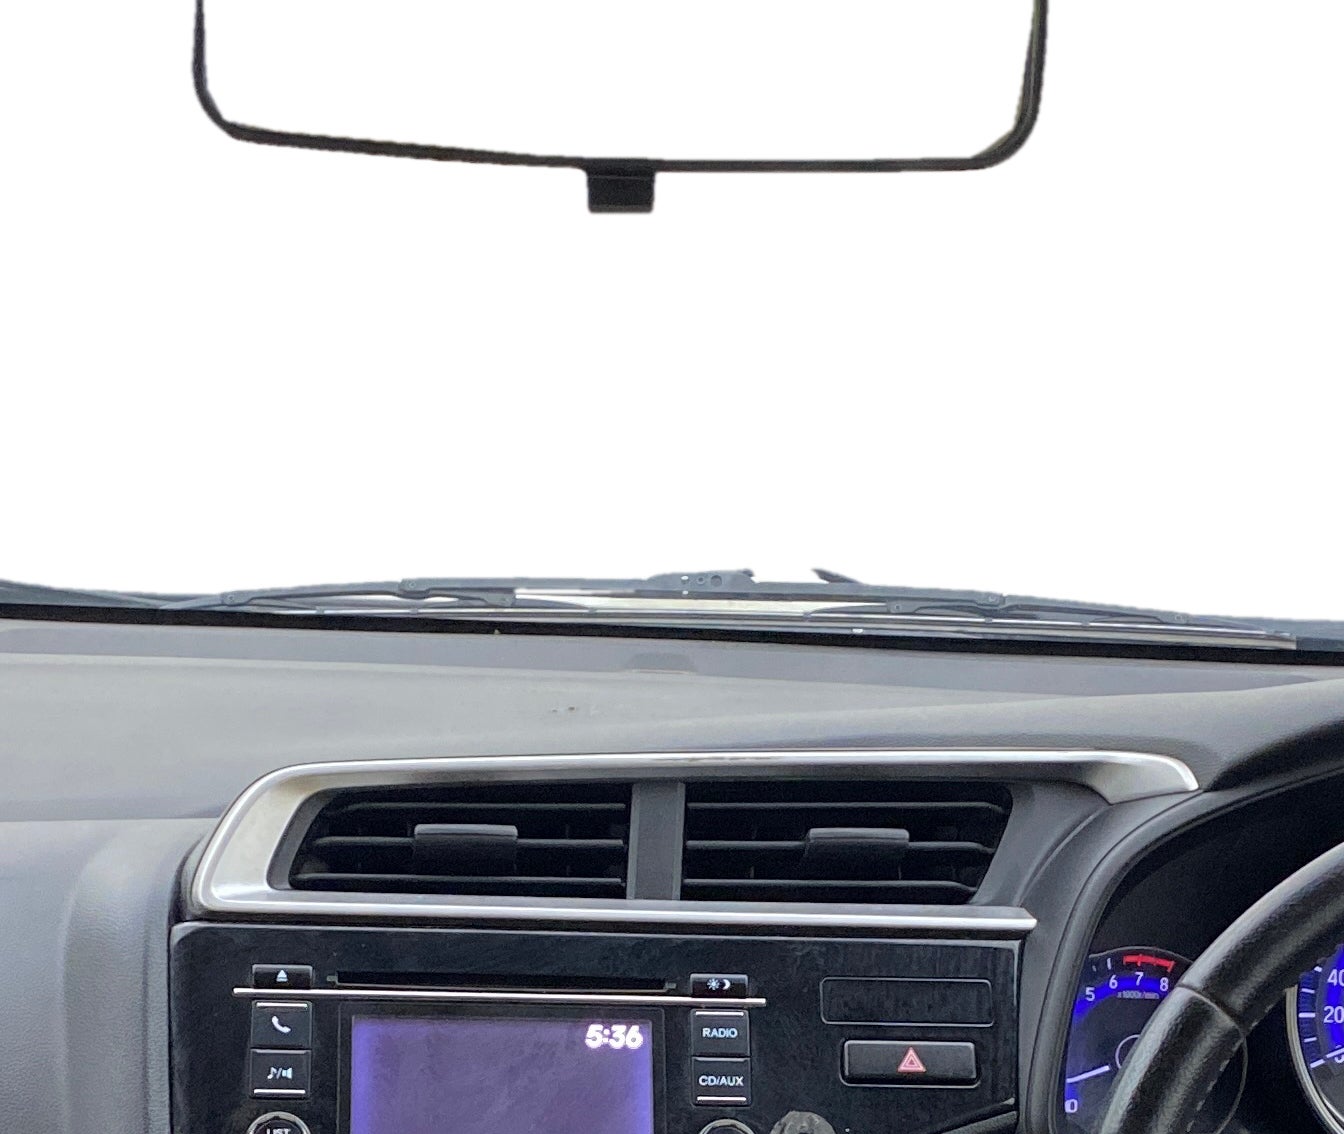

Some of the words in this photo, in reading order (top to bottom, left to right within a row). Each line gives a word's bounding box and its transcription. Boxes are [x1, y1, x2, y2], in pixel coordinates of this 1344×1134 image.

[1109, 974, 1118, 989] 6
[1134, 971, 1144, 986] 7
[1159, 977, 1169, 992] 8
[1084, 986, 1096, 1001] 5
[584, 1024, 644, 1049] 5:36
[702, 1027, 738, 1039] RADIO
[698, 1075, 745, 1087] CD/AUX
